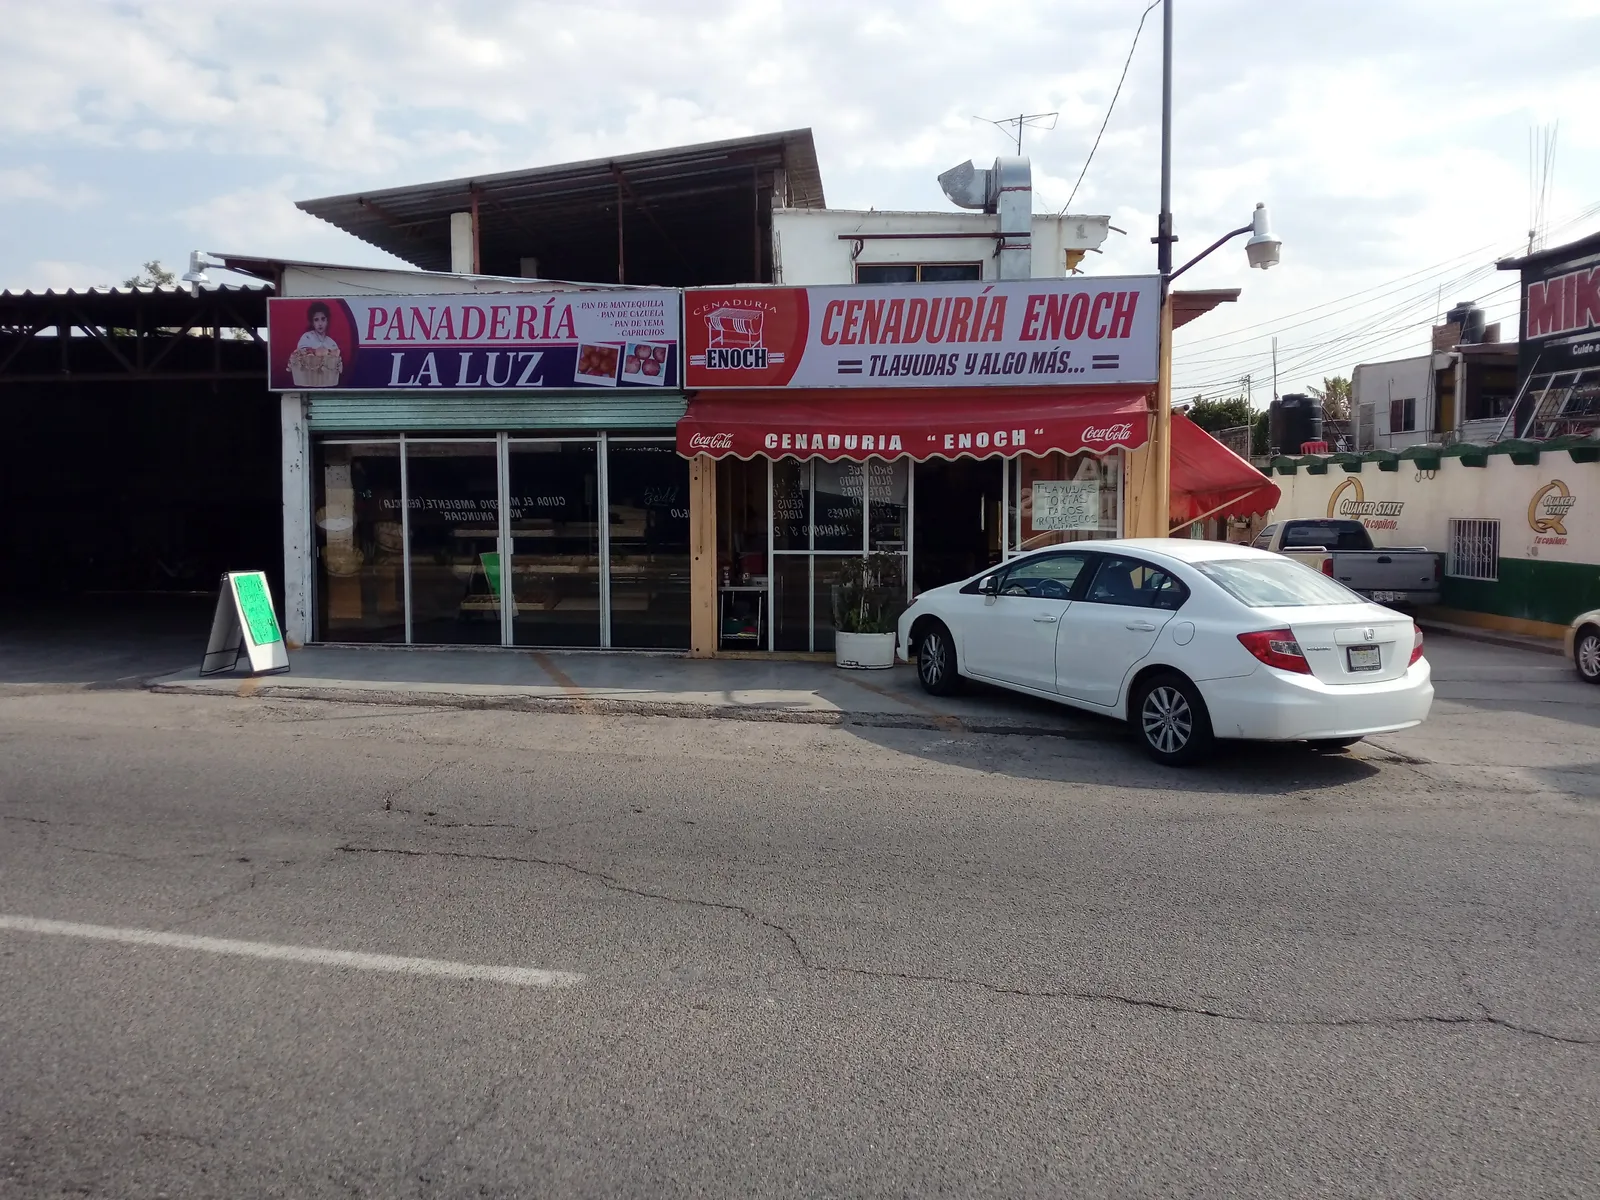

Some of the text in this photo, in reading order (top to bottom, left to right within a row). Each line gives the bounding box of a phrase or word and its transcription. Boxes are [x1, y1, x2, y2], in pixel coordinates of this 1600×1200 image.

[609, 300, 664, 309] MANTEQUILLA
[693, 299, 777, 315] CENADURIA
[365, 297, 579, 341] PANADERÍA
[820, 286, 1140, 346] CENADURÍA ENOCH
[706, 348, 768, 369] ENOCH
[868, 353, 959, 377] TLAYUDAS
[978, 351, 1031, 375] ALGO
[387, 352, 545, 387] LA LUZ
[764, 433, 903, 450] CENADURIA
[1034, 483, 1096, 494] TLAYUDAS
[1340, 498, 1405, 516] QUAKER STATE
[1543, 494, 1576, 507] QUAKER
[1047, 505, 1084, 515] TACOS
[1546, 505, 1570, 515] STATE
